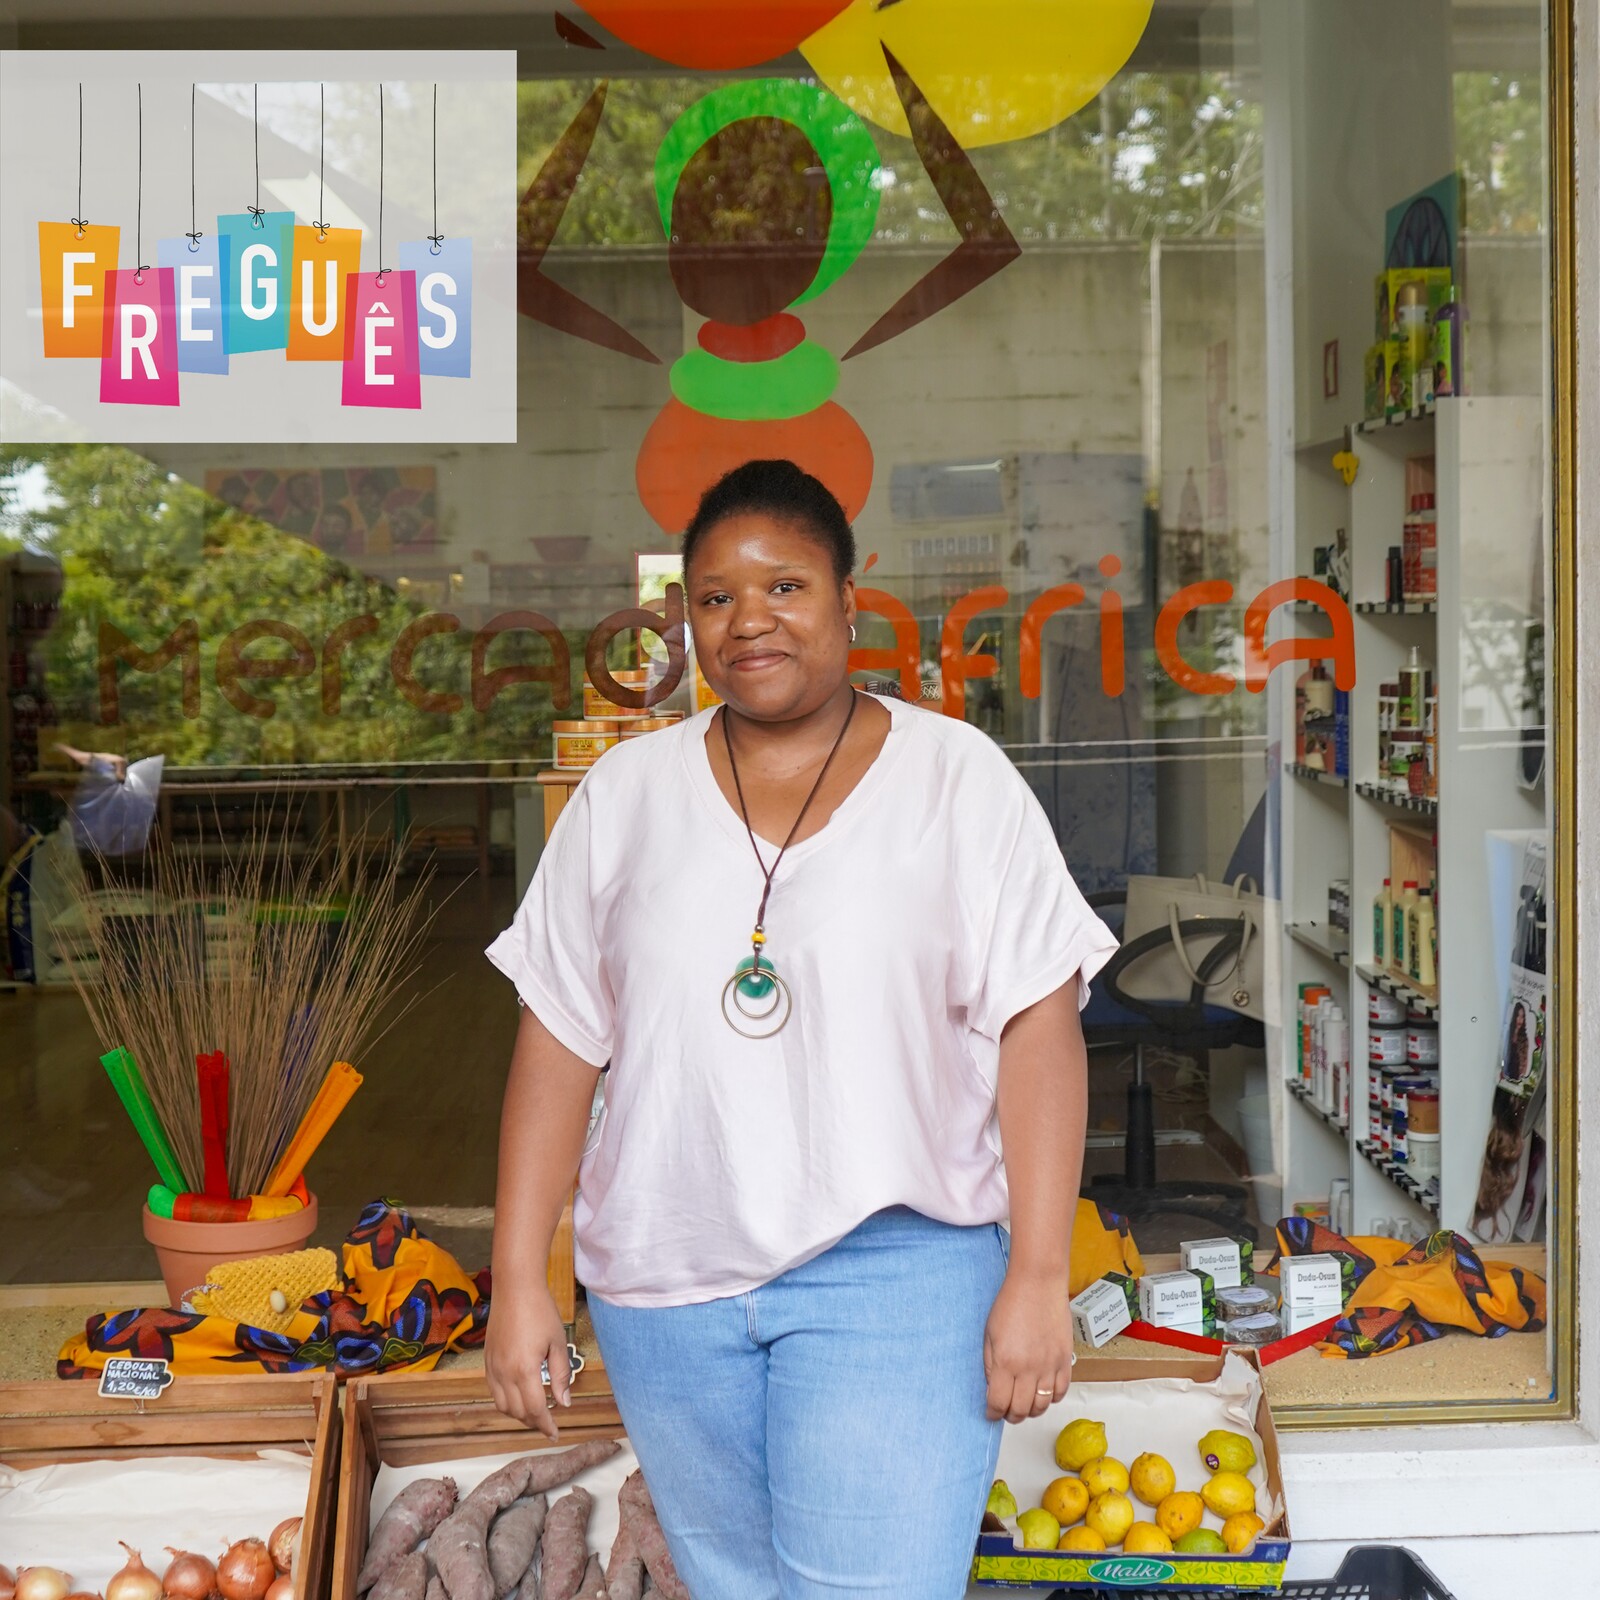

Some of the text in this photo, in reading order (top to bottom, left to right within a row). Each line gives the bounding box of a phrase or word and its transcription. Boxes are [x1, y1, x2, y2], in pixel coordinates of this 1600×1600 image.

[98, 582, 686, 723] Mercad
[1198, 1254, 1237, 1265] Dudu-Osun
[1297, 1272, 1337, 1282] Dudu-Osun
[1160, 1289, 1198, 1302] Dudu-Osun
[1093, 1298, 1123, 1324] Dudu-Osun
[109, 1360, 154, 1372] CEBOLA
[107, 1370, 160, 1380] NACIONAL
[1097, 1562, 1164, 1579] Malki
